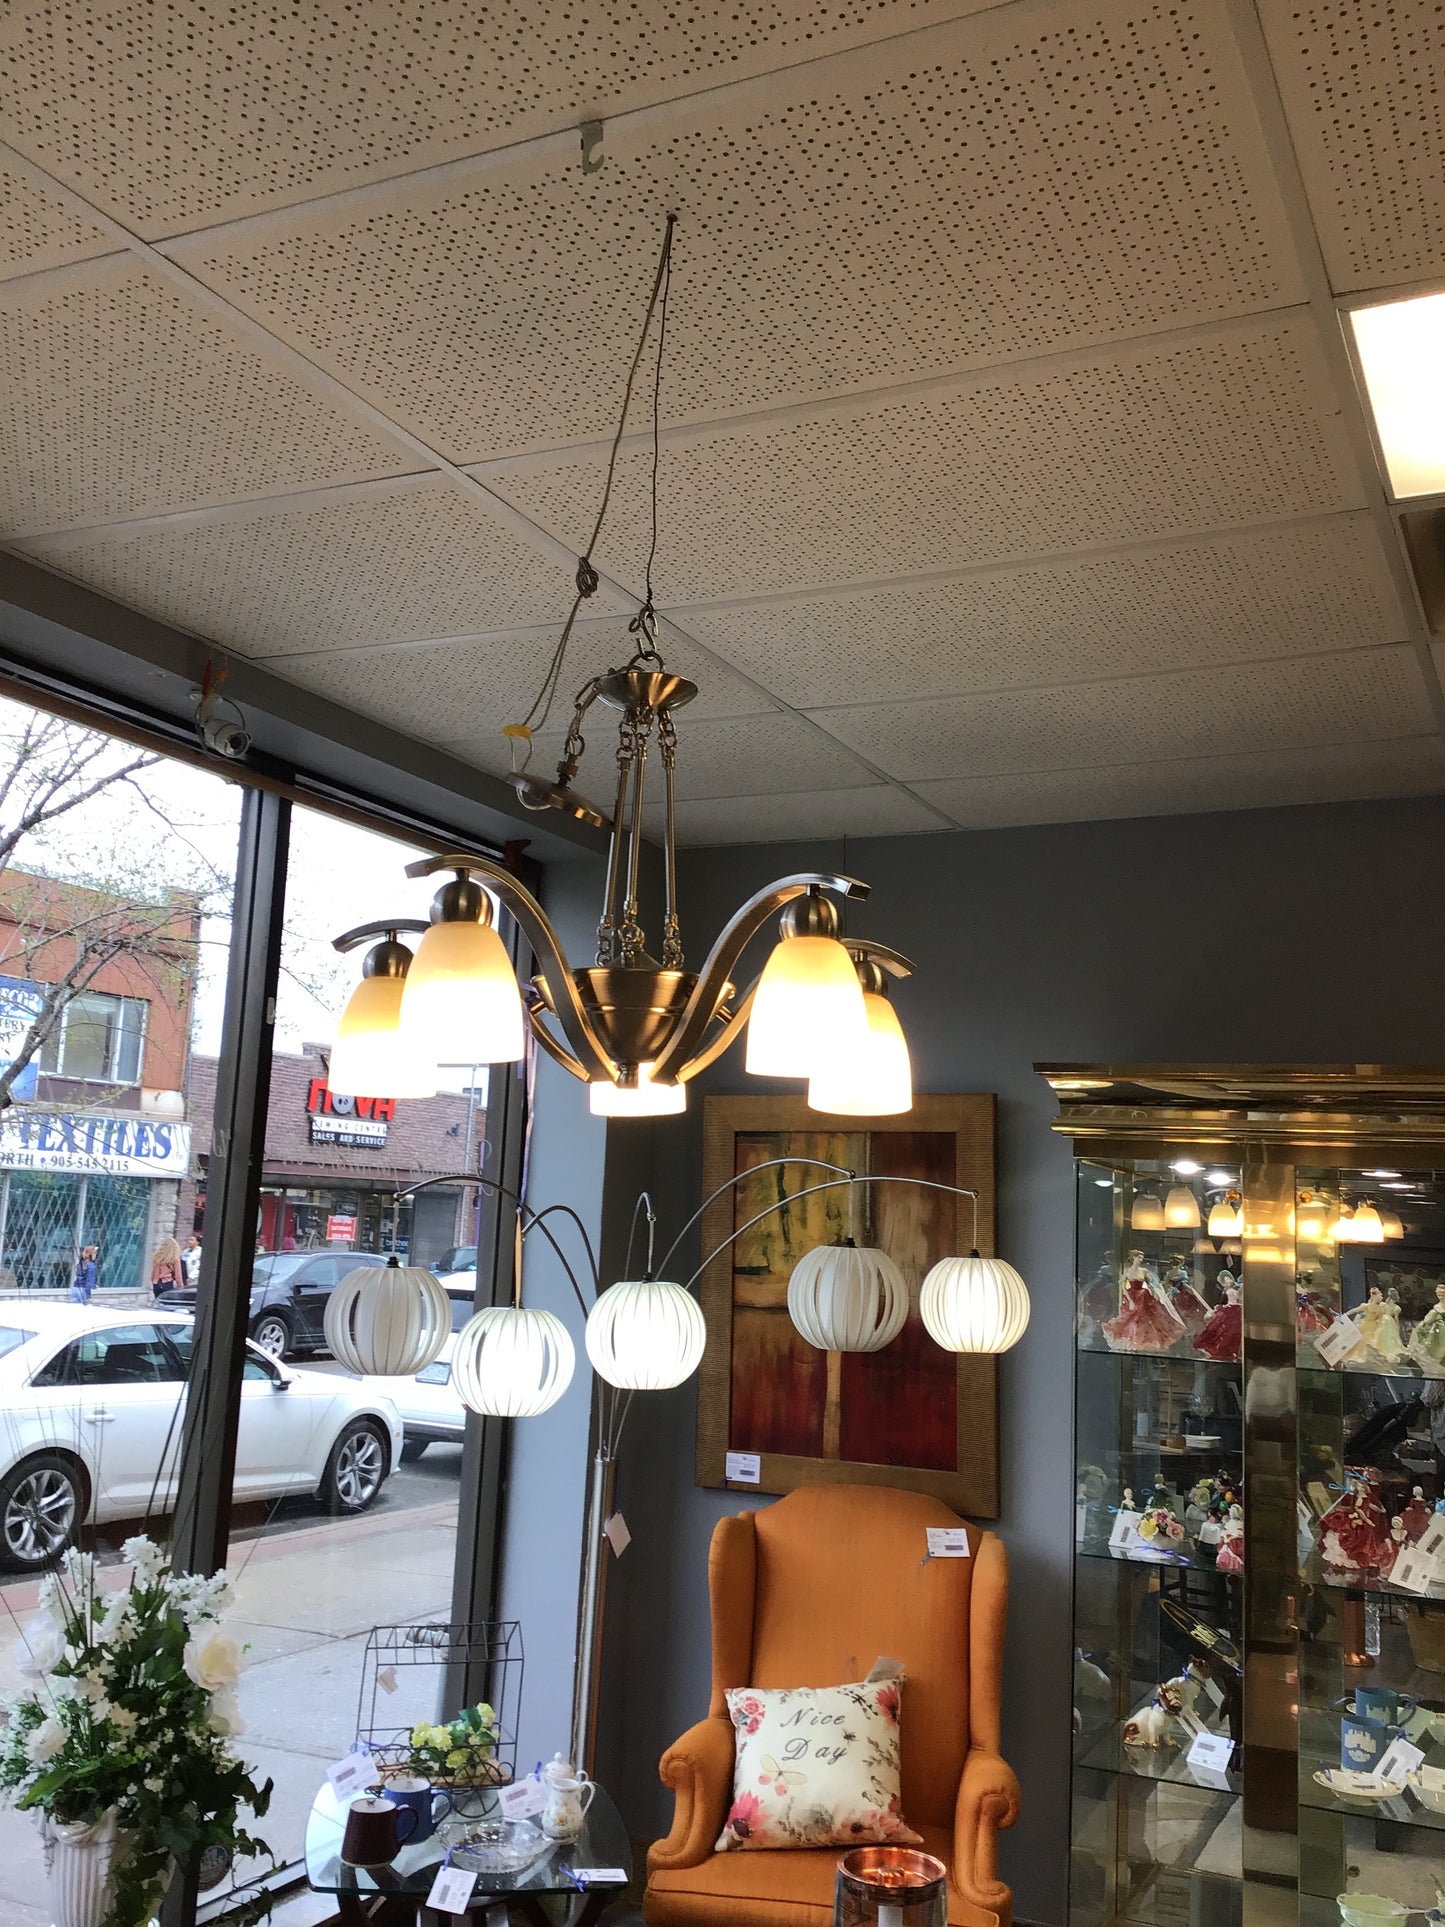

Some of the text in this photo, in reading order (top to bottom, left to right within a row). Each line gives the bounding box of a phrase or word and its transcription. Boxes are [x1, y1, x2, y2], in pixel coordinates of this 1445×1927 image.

[15, 1110, 173, 1159] TEXTILES
[312, 1131, 386, 1147] SALES AND SERVICE
[780, 1707, 846, 1728] Nice
[781, 1737, 848, 1766] Day
